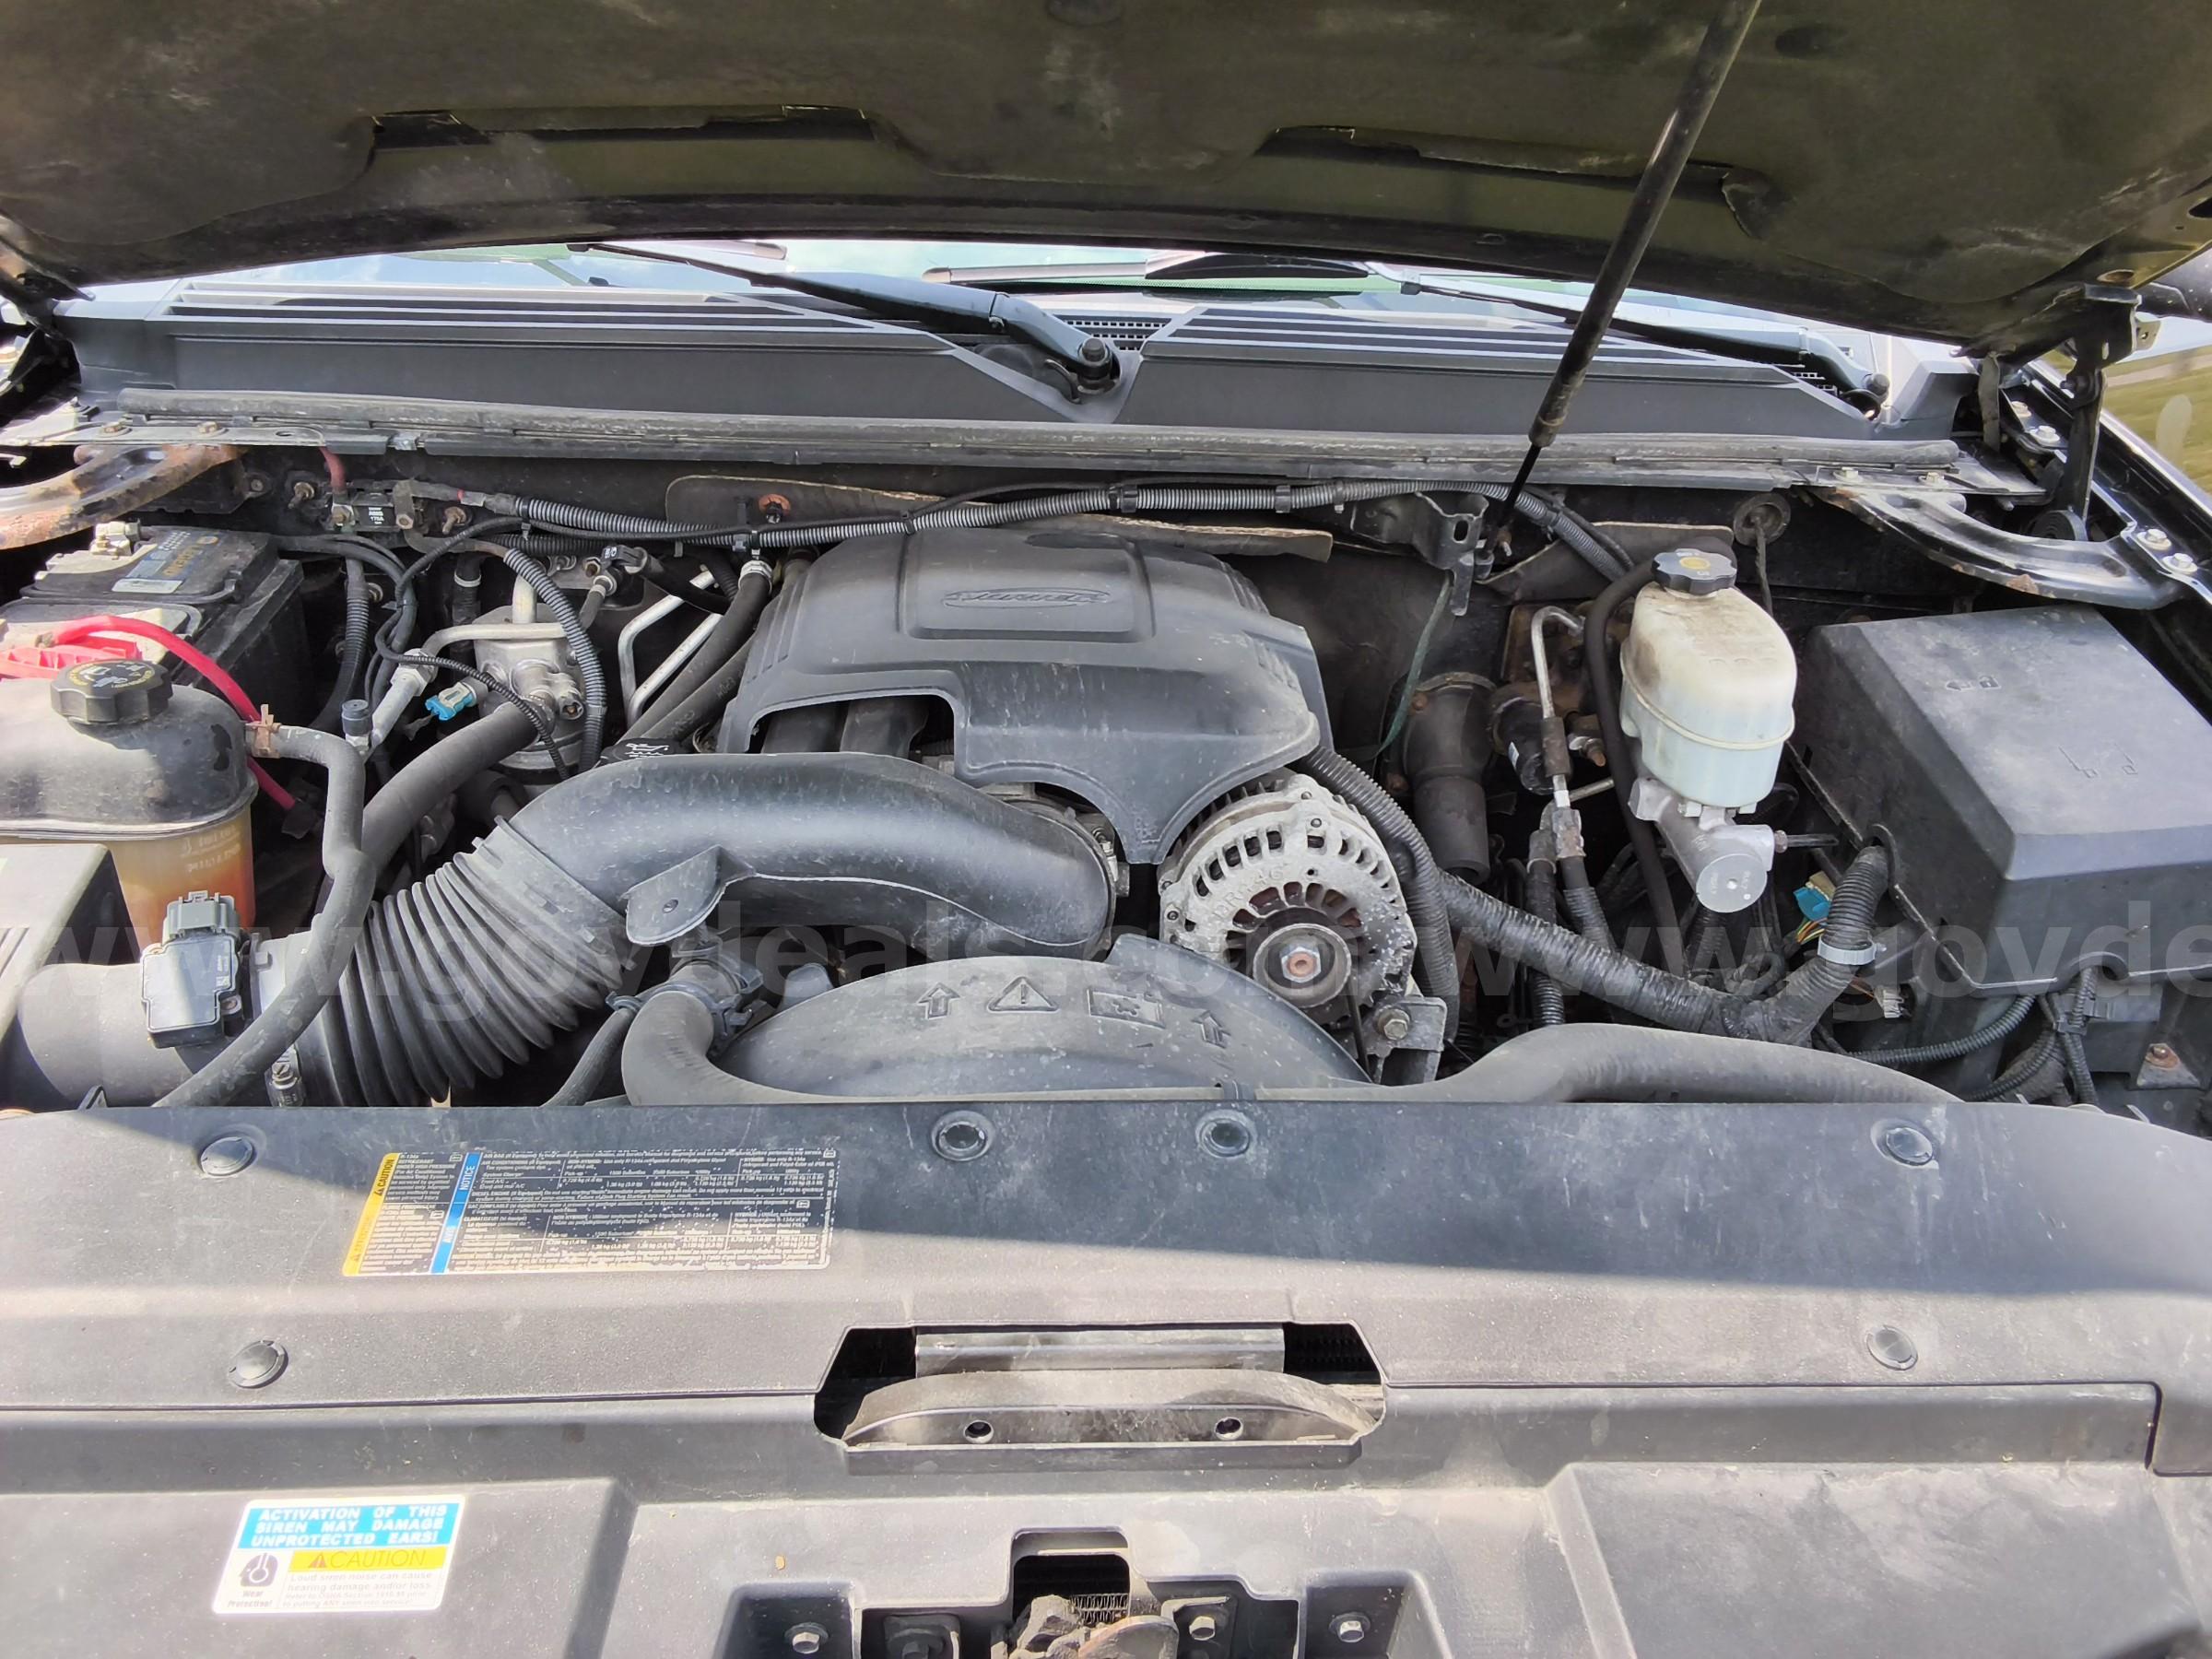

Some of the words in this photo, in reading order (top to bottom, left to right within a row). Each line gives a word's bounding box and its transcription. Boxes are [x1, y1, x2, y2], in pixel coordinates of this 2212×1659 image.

[378, 1159, 394, 1187] CAUTION
[459, 1166, 475, 1190] NOTICE
[259, 1508, 360, 1521] ACTIVATION
[374, 1506, 395, 1519] OF
[409, 1504, 447, 1517] THIS
[254, 1521, 308, 1534] SIREN
[321, 1520, 359, 1533] MAY
[372, 1517, 443, 1531] DAMAGE
[251, 1533, 376, 1547] UNPROTECTED
[388, 1531, 438, 1544] EARS!
[330, 1549, 427, 1569] CAUTION
[288, 1583, 326, 1594] hearing
[330, 1582, 370, 1594] damage
